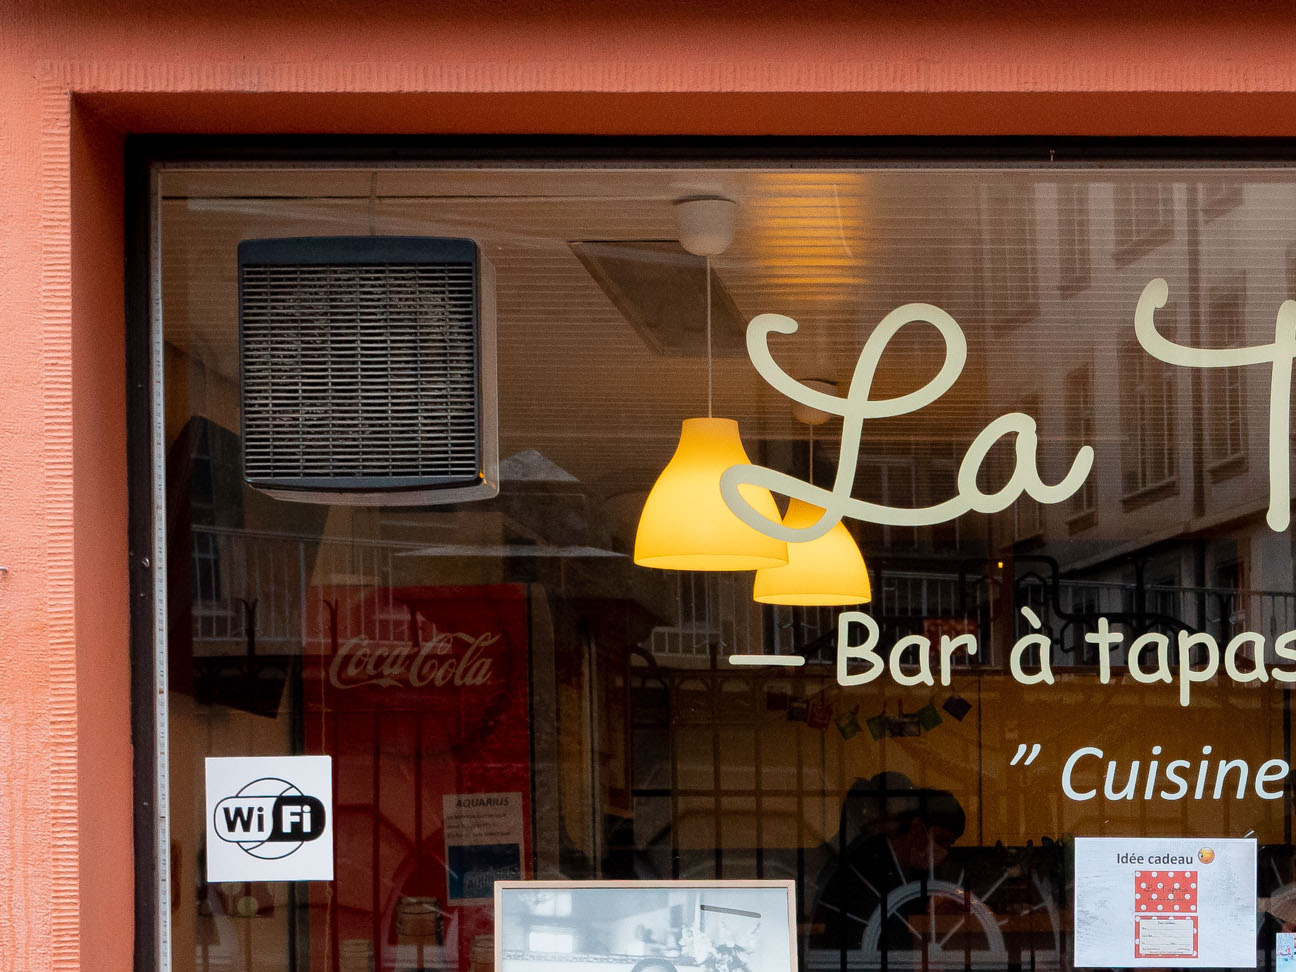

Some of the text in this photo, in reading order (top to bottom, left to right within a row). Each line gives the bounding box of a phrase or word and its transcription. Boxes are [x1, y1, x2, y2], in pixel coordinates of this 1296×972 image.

[719, 302, 1094, 543] La
[835, 610, 980, 688] Bar
[1010, 606, 1056, 686] à
[1060, 745, 1290, 803] Cuisine
[1116, 852, 1194, 865] Idée cadeau
